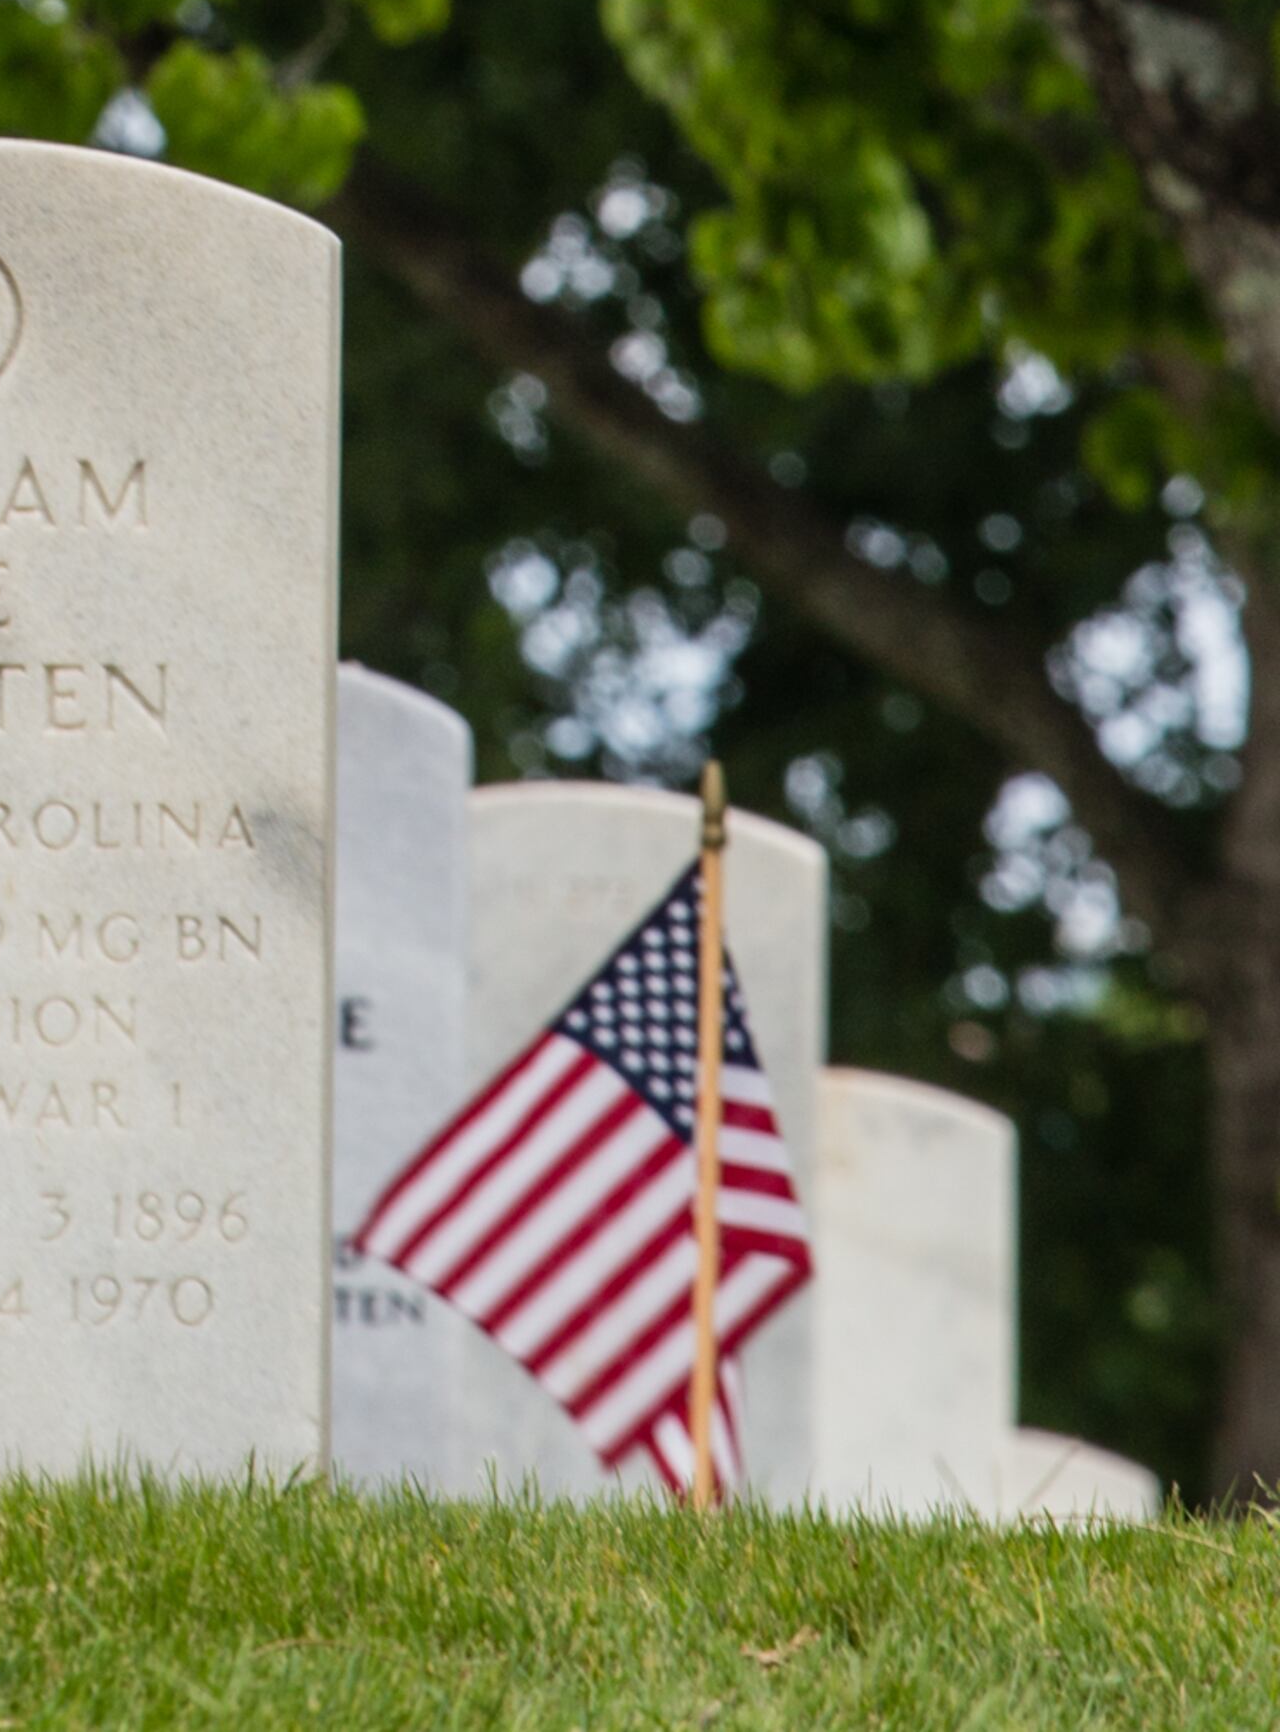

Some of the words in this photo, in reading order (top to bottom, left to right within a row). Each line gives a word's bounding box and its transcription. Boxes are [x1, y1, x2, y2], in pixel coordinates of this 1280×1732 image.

[38, 912, 142, 963] MG
[175, 913, 262, 962] BN
[40, 1191, 72, 1242] 3
[112, 1190, 249, 1244] 1896
[70, 1274, 216, 1327] 1970
